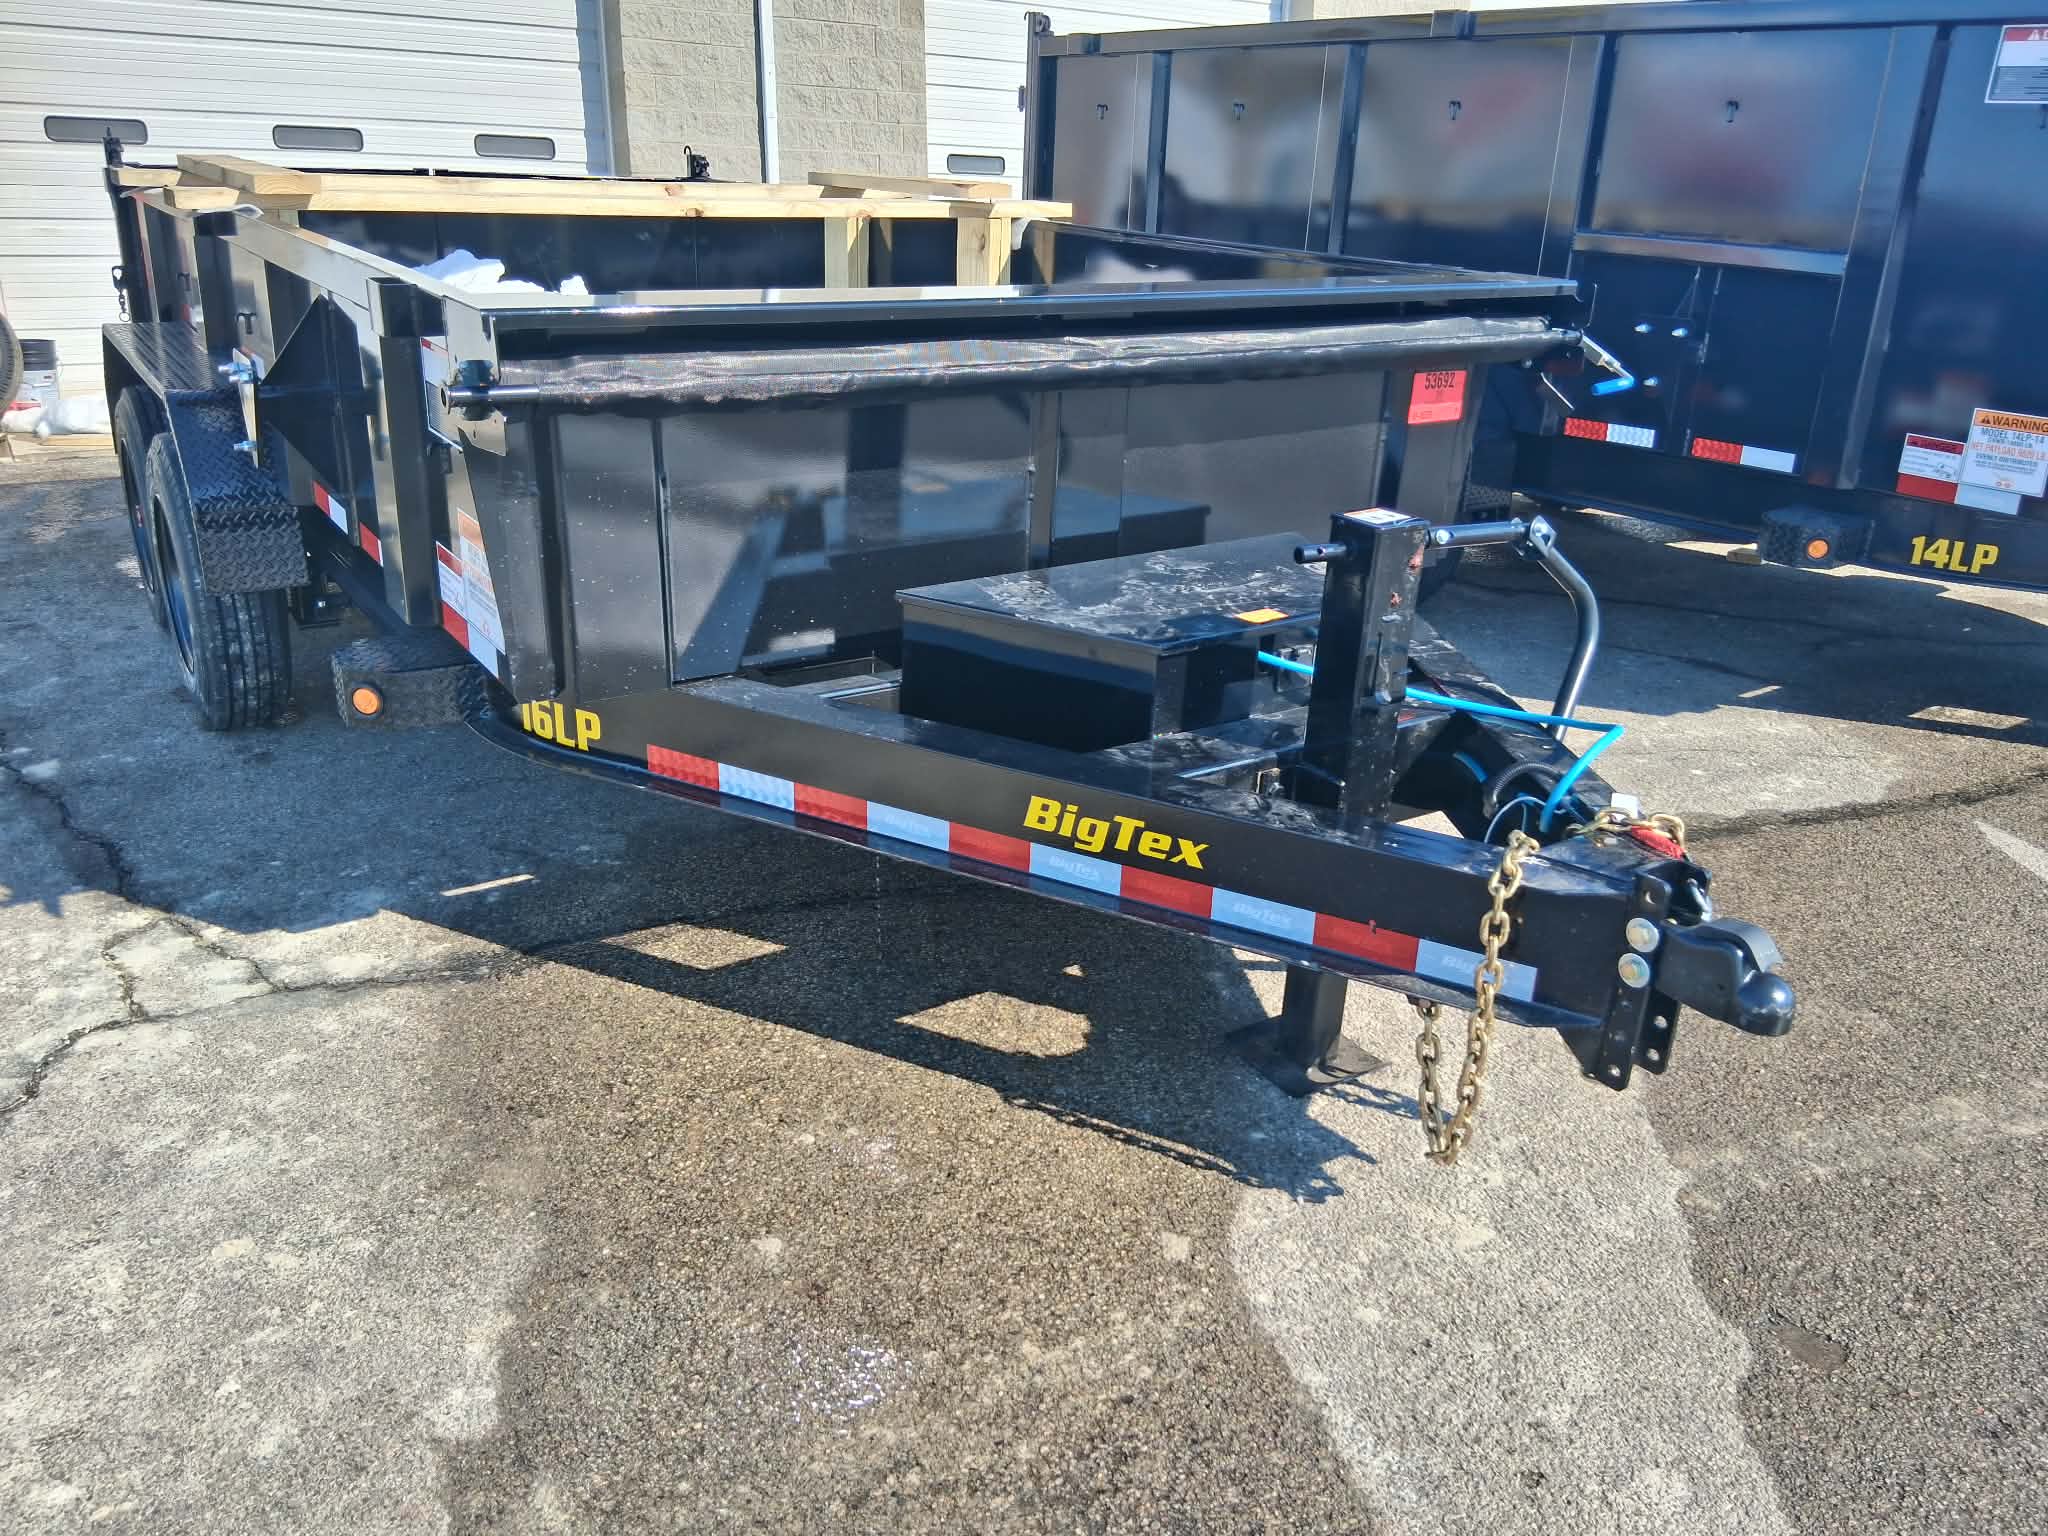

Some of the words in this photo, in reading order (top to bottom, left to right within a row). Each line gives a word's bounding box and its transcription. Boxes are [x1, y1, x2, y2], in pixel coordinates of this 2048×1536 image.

[1992, 415, 2048, 433] WARNING
[1910, 535, 1999, 574] 14LP
[521, 700, 601, 752] 16LP
[1023, 795, 1210, 870] BigTex
